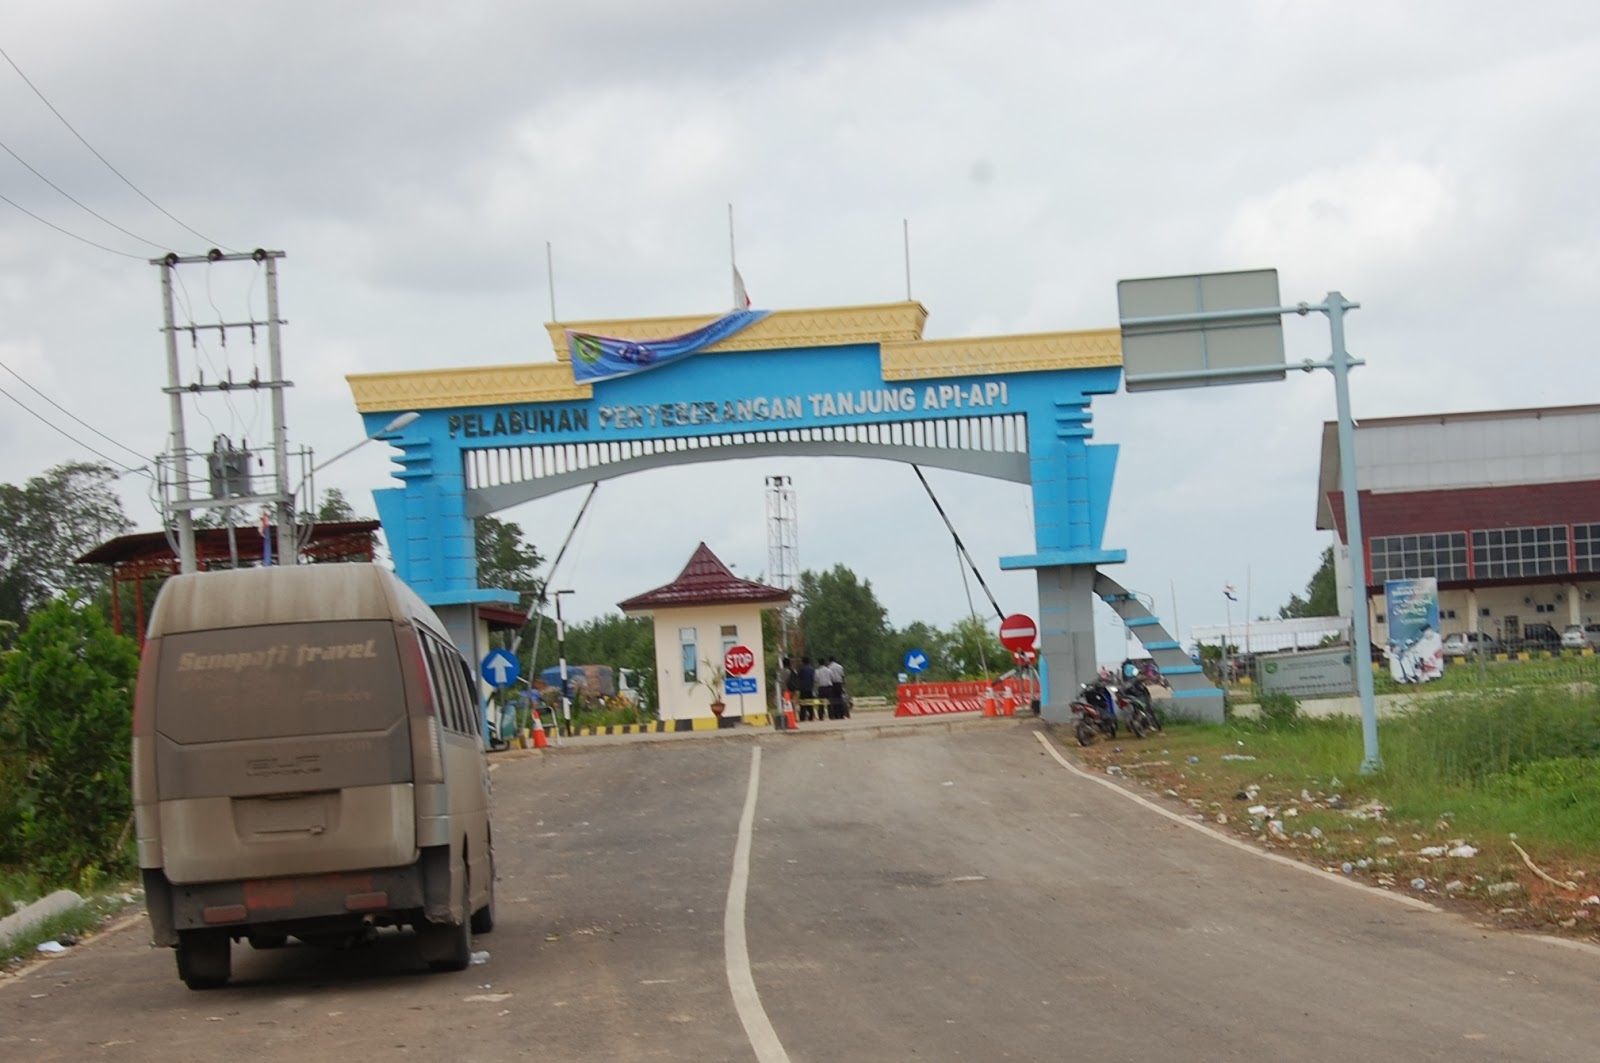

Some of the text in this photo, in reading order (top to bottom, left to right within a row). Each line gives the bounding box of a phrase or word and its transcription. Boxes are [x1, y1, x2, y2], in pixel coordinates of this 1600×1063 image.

[449, 381, 1008, 438] PELABUHAN PENYEBERANGAN TANJUNG API-API
[726, 653, 752, 669] STOP
